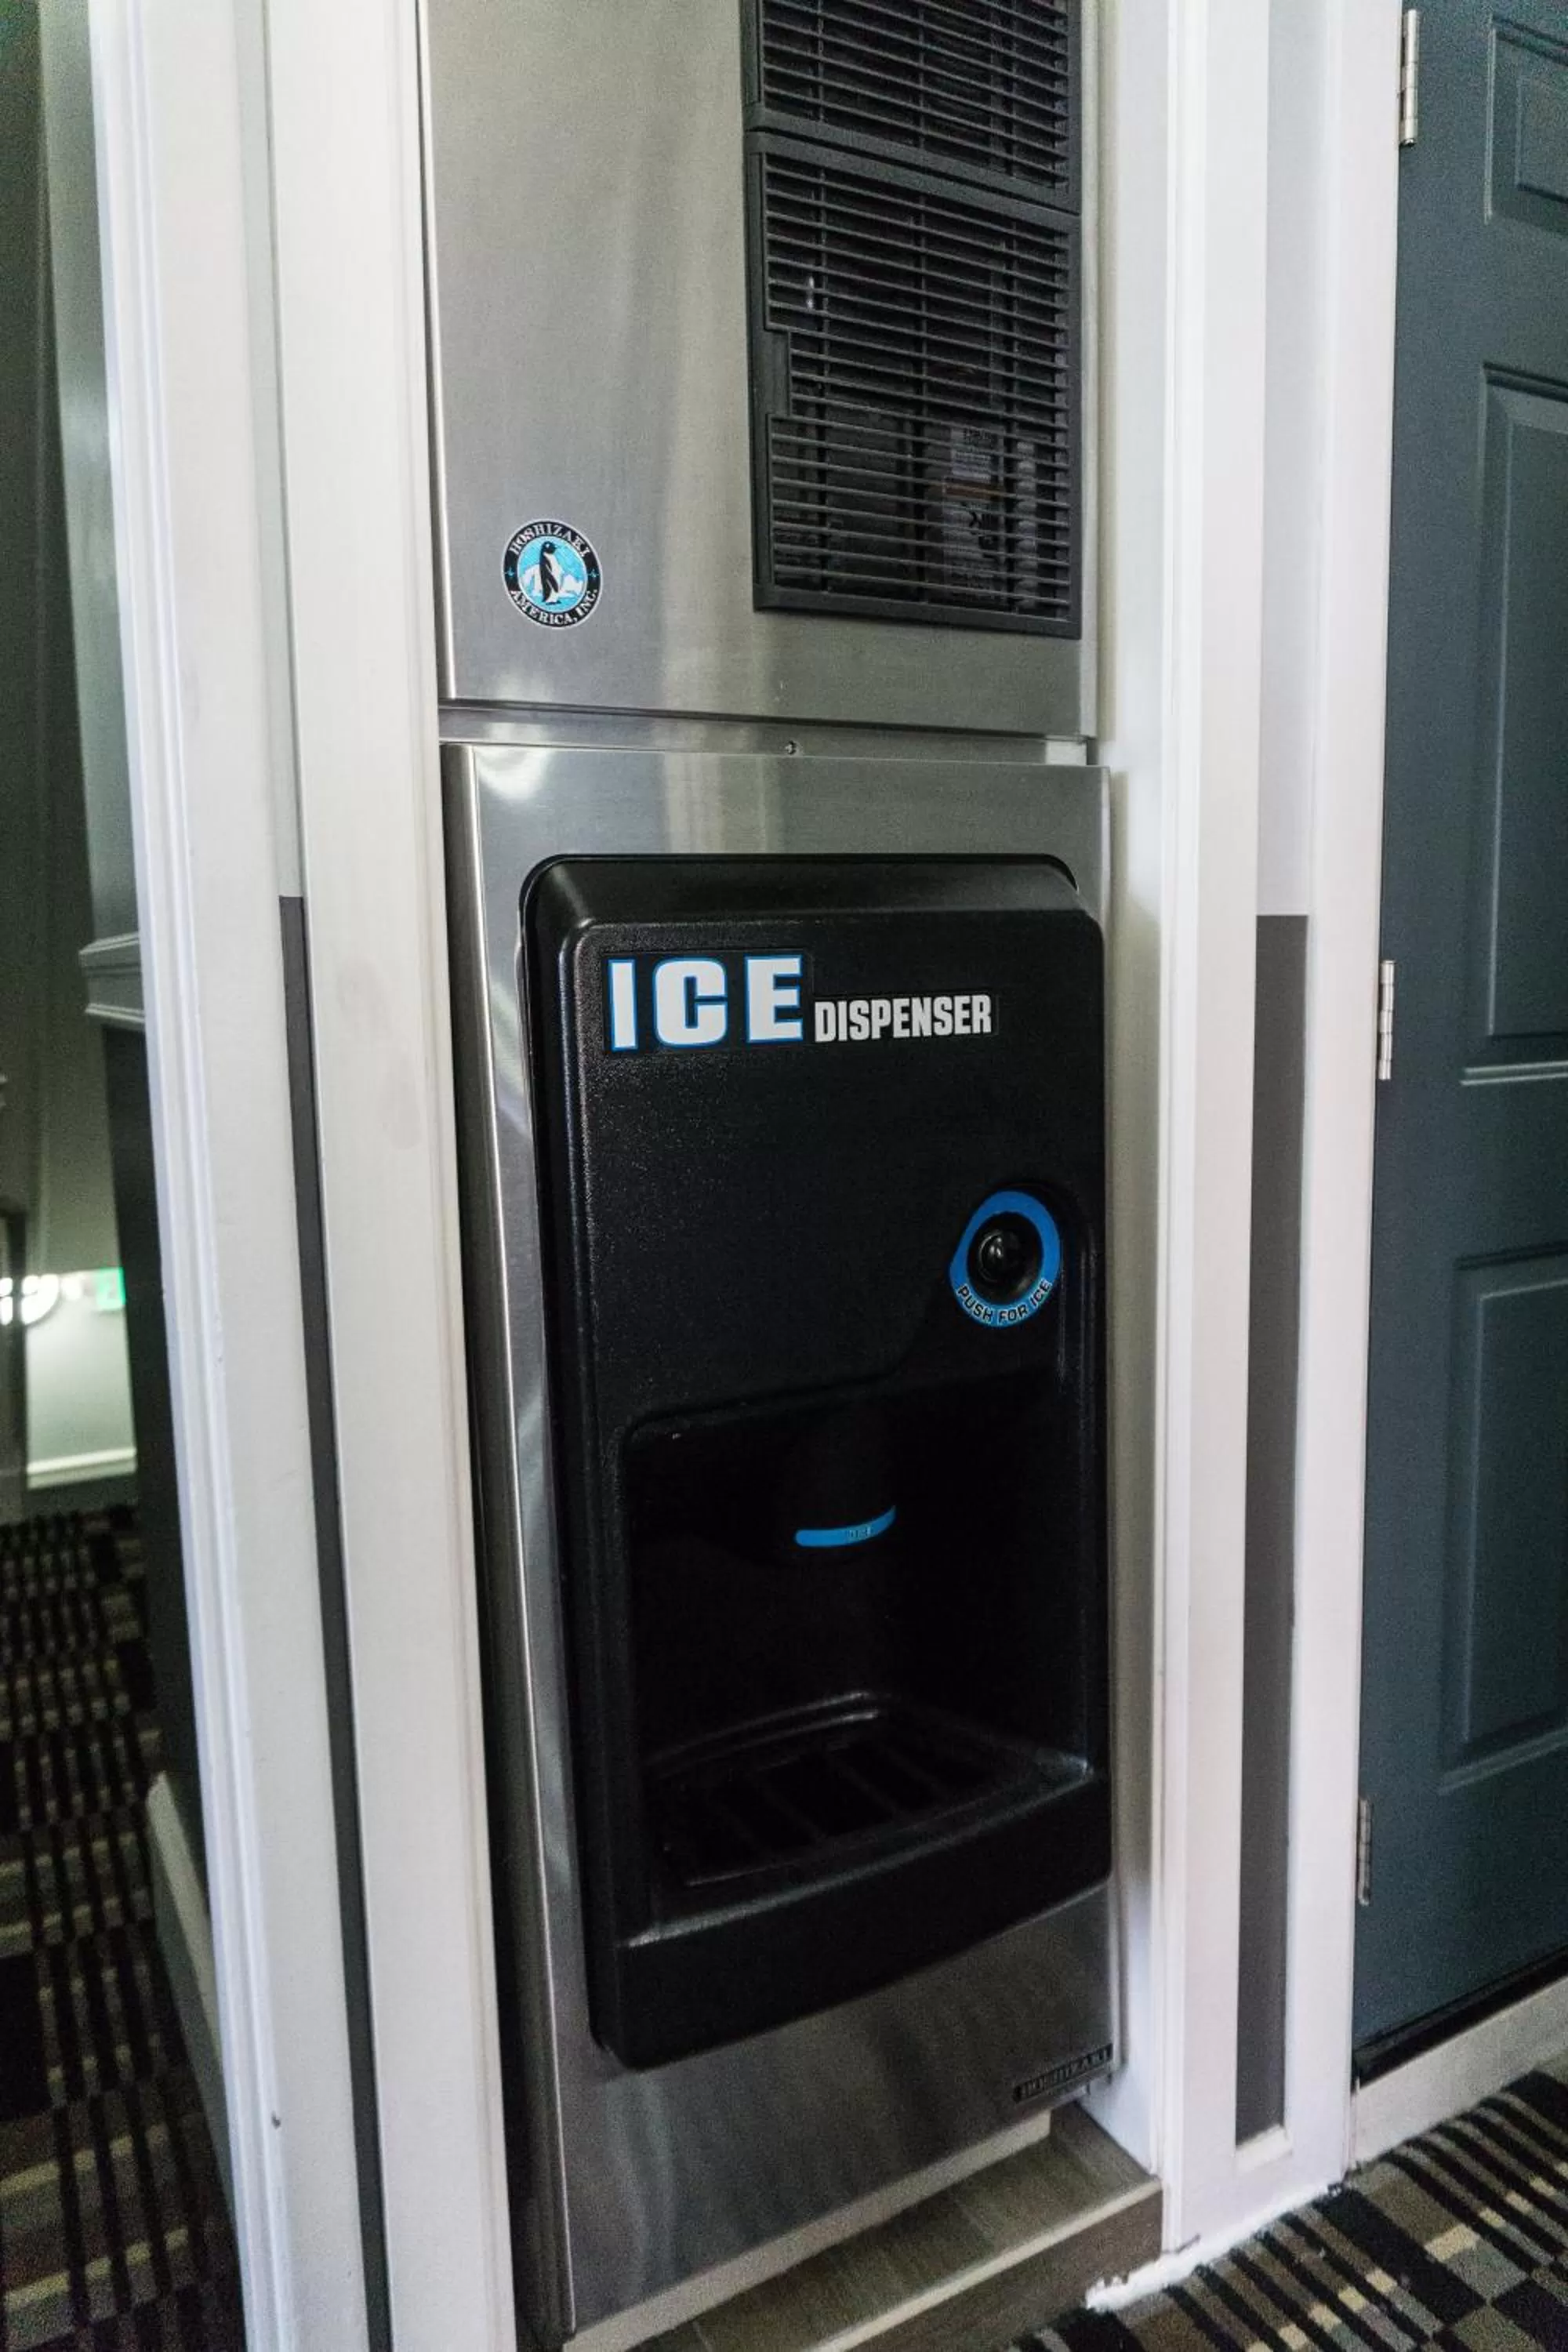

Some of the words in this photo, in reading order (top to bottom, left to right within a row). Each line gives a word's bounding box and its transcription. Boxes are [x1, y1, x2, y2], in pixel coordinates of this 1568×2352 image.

[510, 524, 590, 557] HOSHIZAKI
[511, 590, 578, 625] AMERICA,
[575, 590, 597, 618] INC.
[608, 955, 804, 1051] ICE
[815, 994, 992, 1044] DISPENSER
[957, 1283, 993, 1323] PUSH
[998, 1305, 1029, 1323] FOR
[1029, 1278, 1052, 1308] ICE
